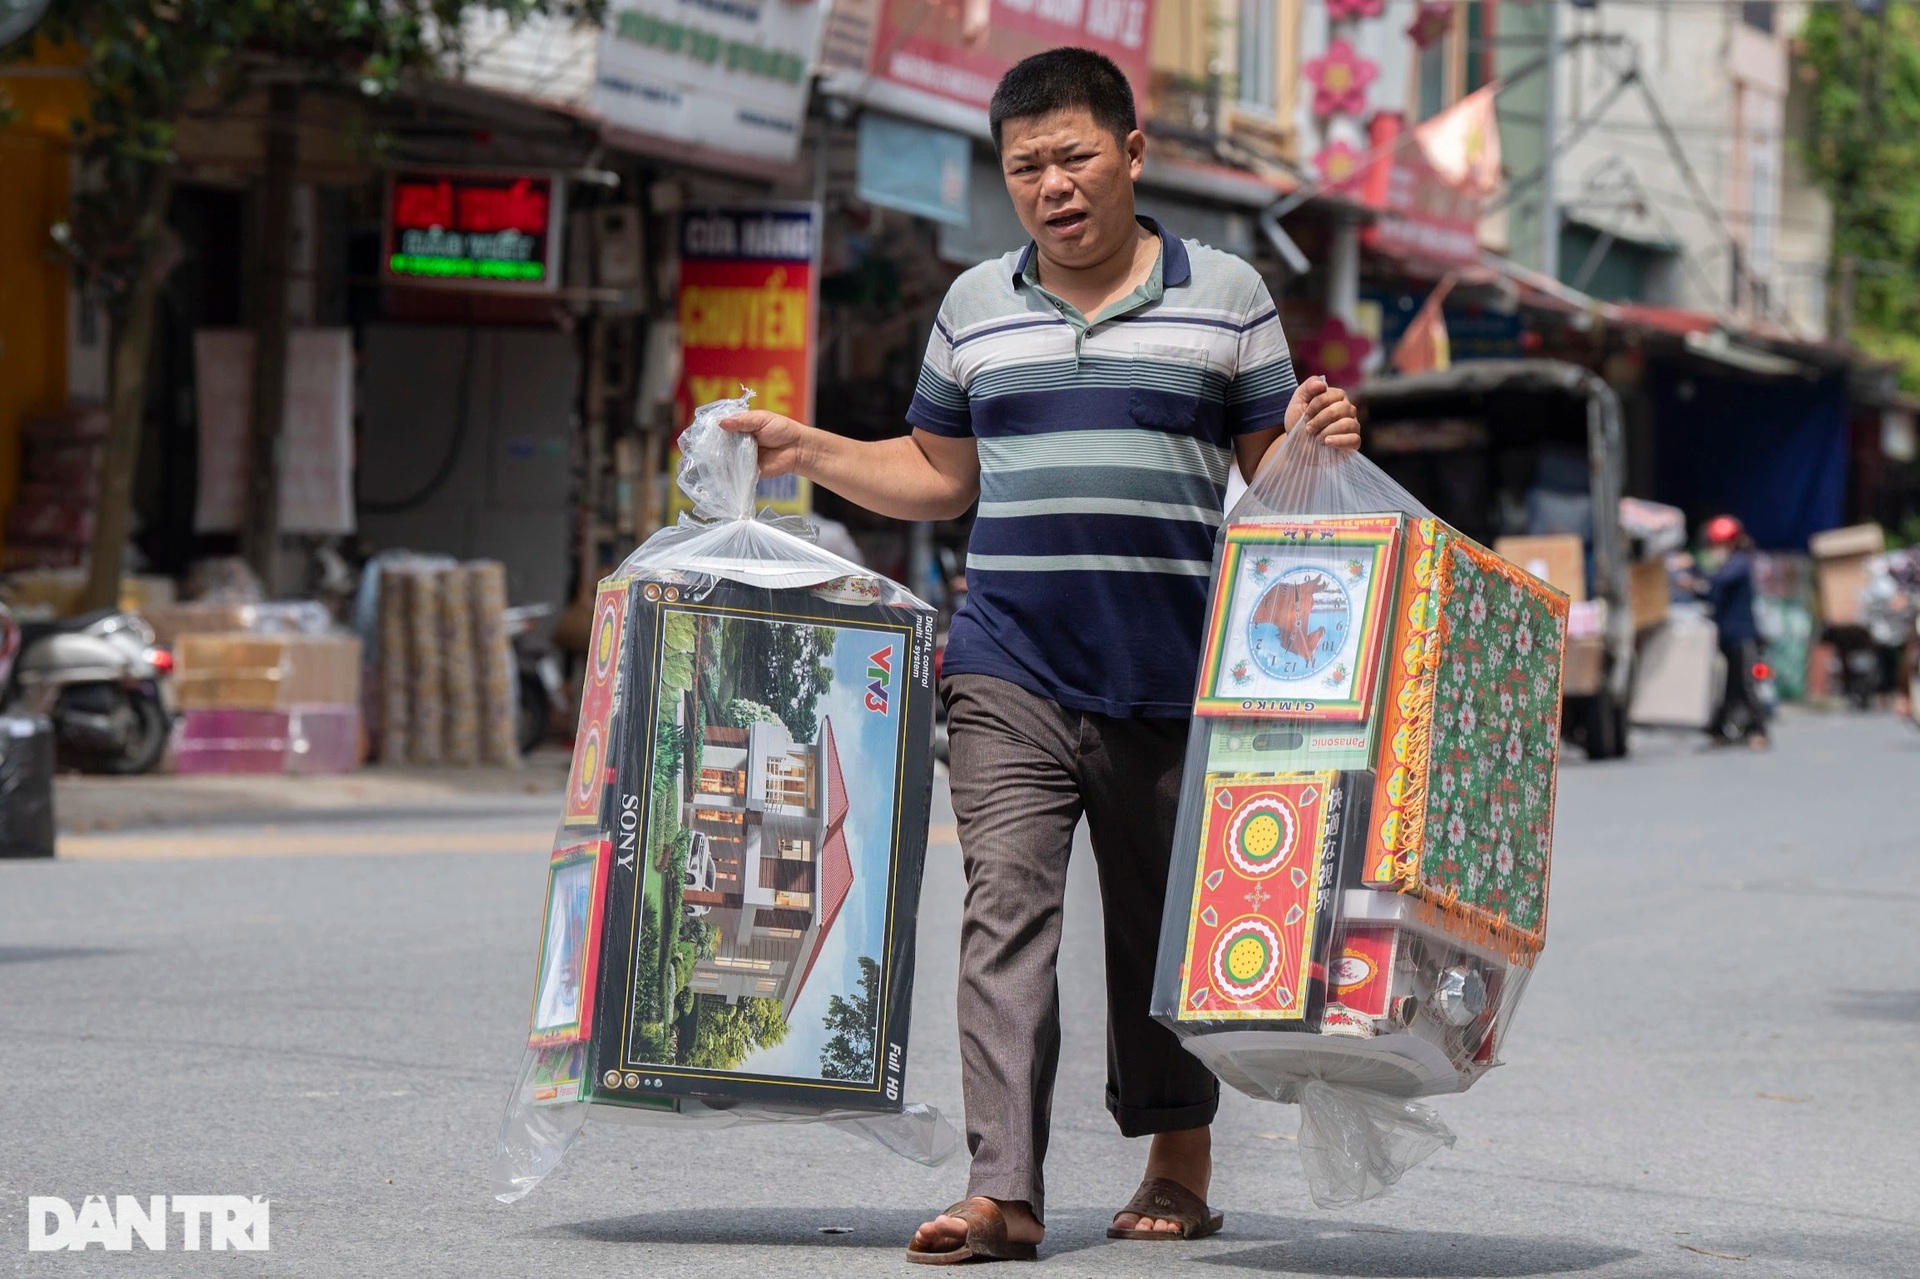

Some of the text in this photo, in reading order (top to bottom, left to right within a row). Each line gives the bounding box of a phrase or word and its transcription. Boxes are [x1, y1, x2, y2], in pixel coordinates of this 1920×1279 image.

[915, 614, 923, 639] multi
[1335, 620, 1343, 631] 9
[921, 615, 934, 688] DIGITAL control
[1256, 638, 1263, 650] 2
[1322, 641, 1335, 652] 10
[912, 644, 921, 678] system
[1283, 662, 1297, 673] 12
[864, 644, 893, 717] VTV3
[1241, 700, 1315, 711] GIMIKO
[1312, 737, 1365, 749] Panasonic
[617, 794, 639, 873] SONY
[886, 1042, 902, 1101] Full HD
